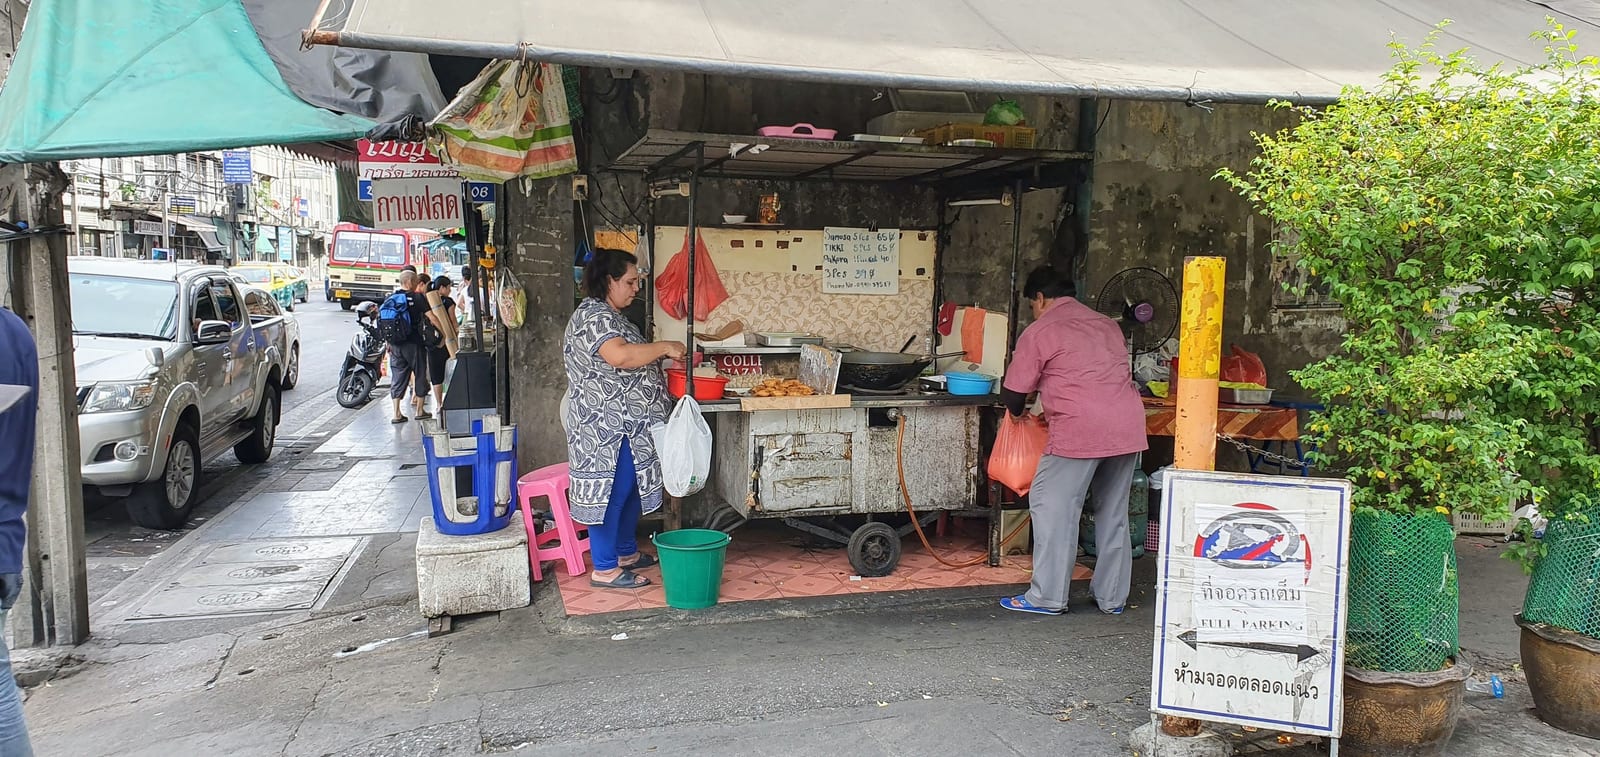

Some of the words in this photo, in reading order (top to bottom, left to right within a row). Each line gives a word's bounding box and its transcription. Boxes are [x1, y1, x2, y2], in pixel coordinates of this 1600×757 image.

[377, 185, 459, 222] กาแฟสด
[824, 228, 851, 242] Samosa
[824, 243, 844, 252] TIKKI
[1201, 575, 1301, 601] ที่จอดรถเต็ม
[1201, 619, 1231, 629] FULL
[1242, 619, 1303, 631] PARKING
[1173, 661, 1320, 700] ห้ามจอดตลอดแนว
